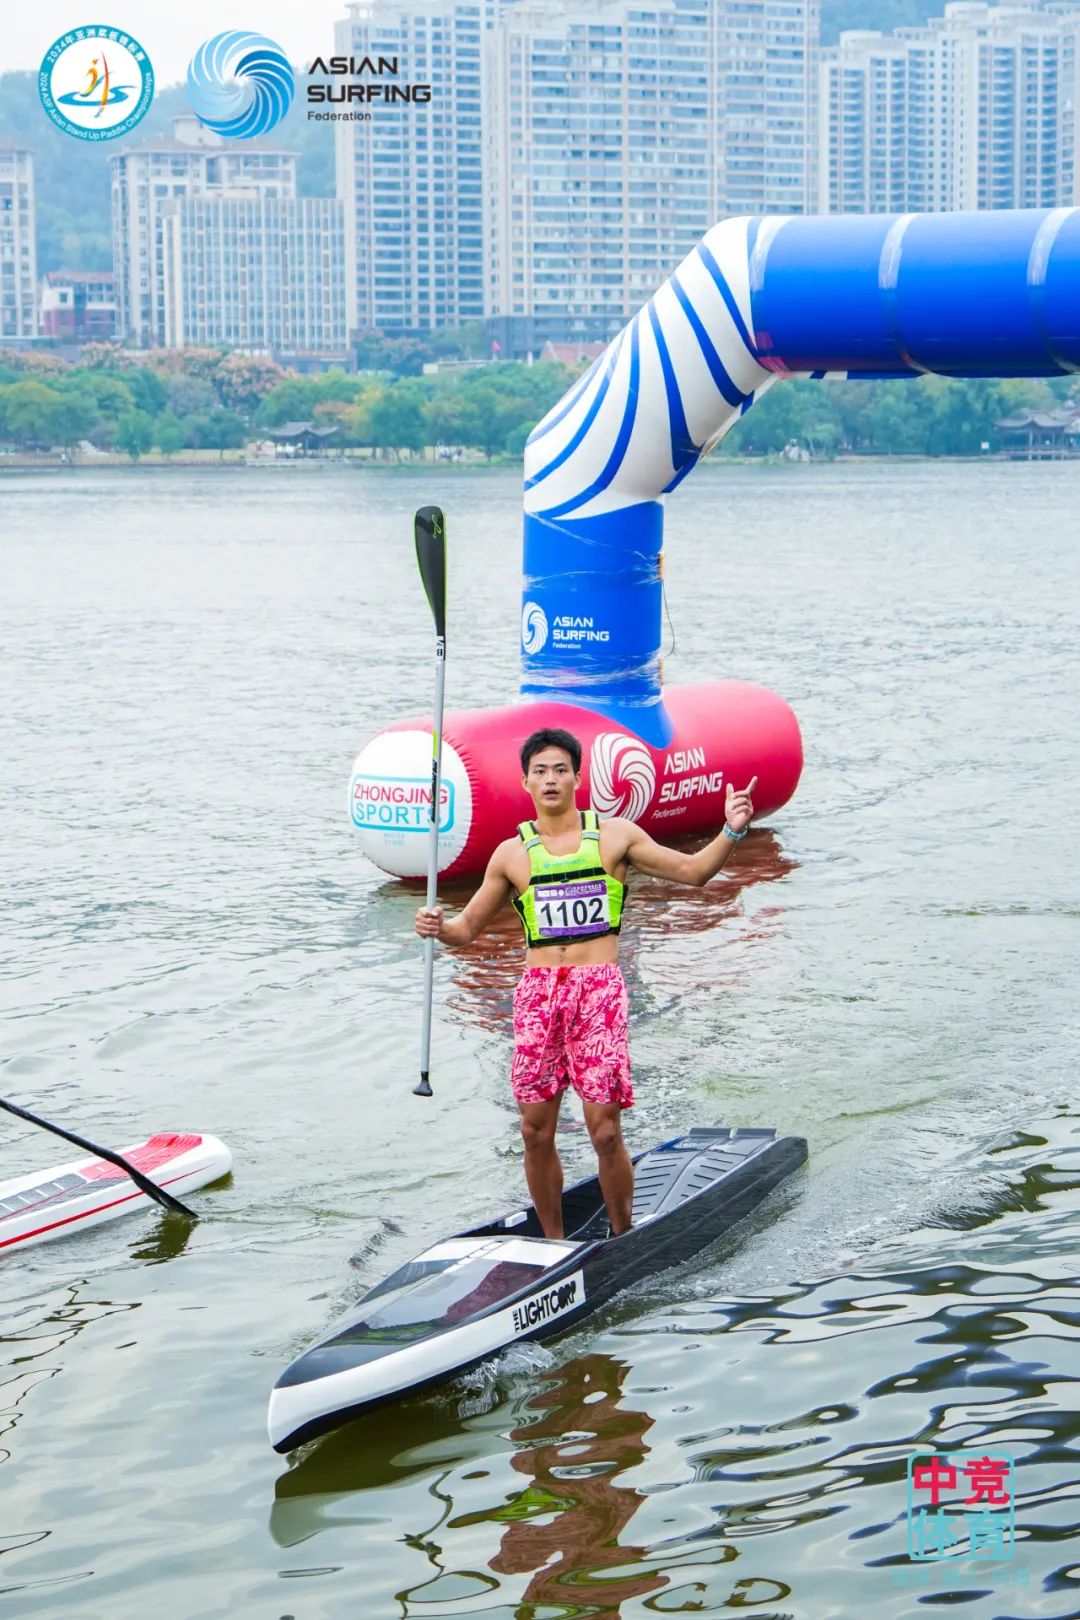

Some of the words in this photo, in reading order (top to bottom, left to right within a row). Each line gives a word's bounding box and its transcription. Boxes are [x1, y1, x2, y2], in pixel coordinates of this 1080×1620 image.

[552, 616, 593, 628] ASIAN
[552, 629, 610, 641] SURFING
[664, 746, 706, 776] ASIAN
[354, 783, 448, 805] ZHONGJING
[659, 771, 723, 804] SURFING
[540, 897, 605, 927] 1102
